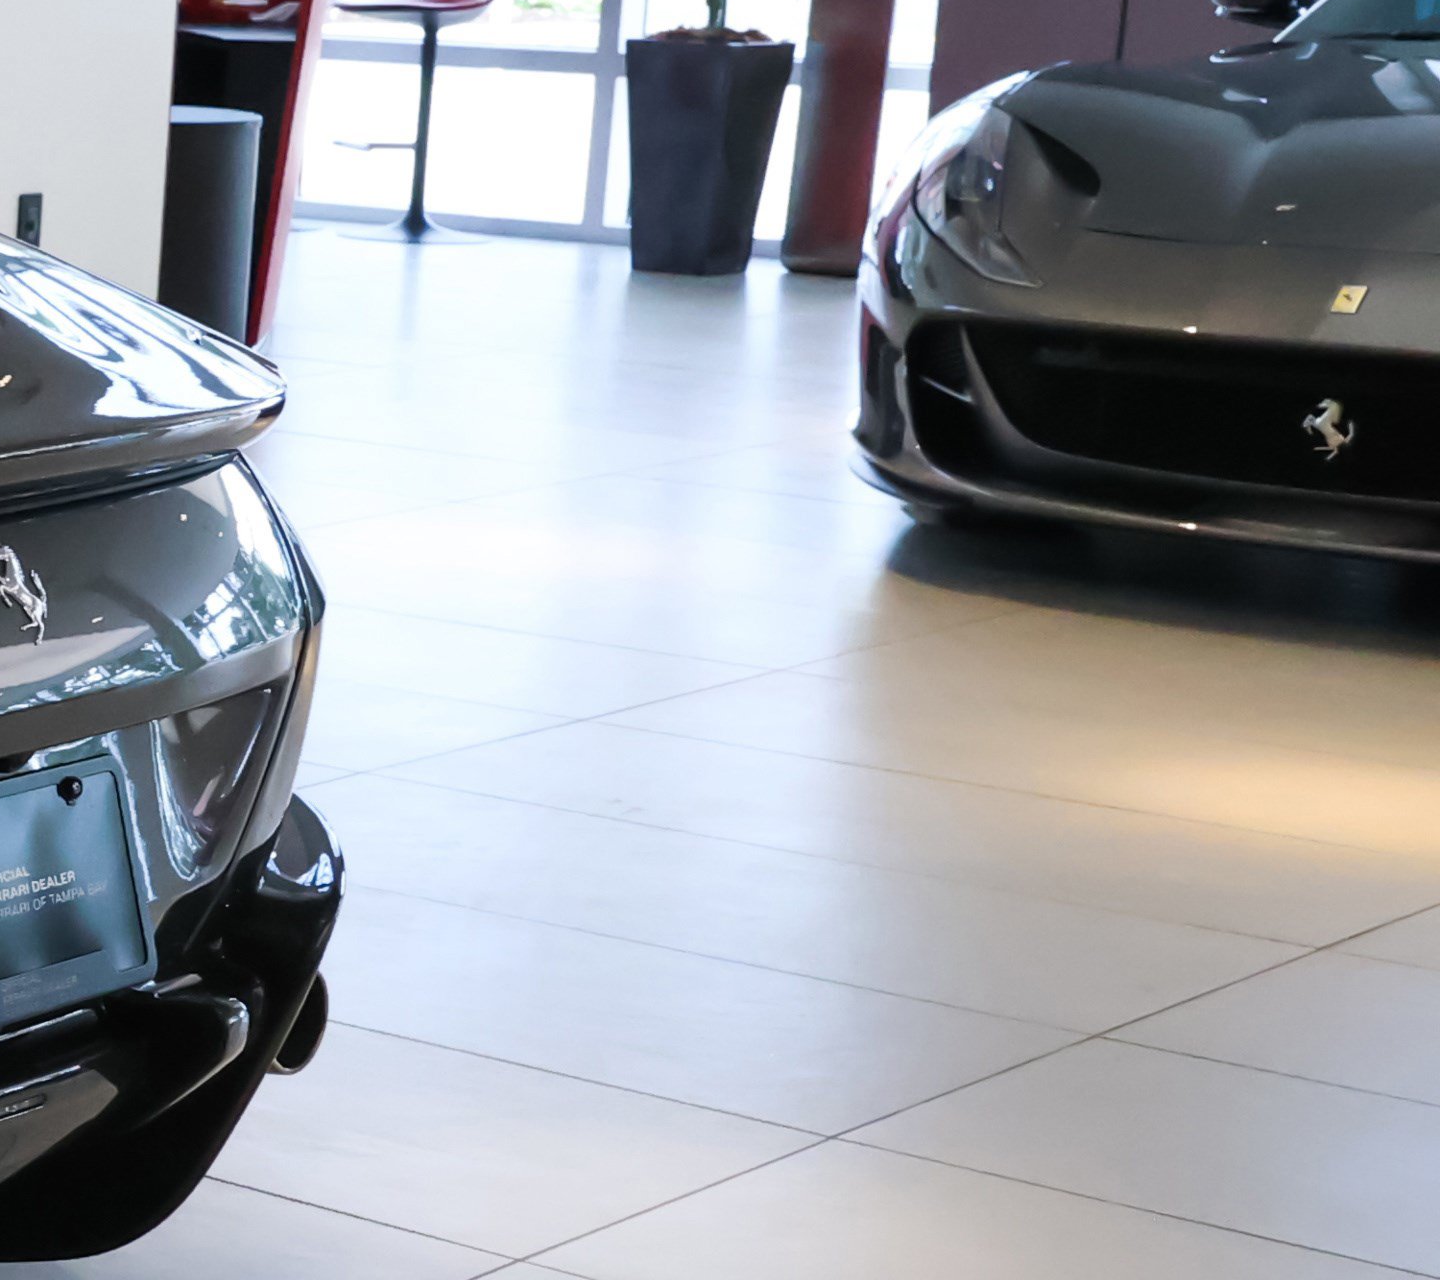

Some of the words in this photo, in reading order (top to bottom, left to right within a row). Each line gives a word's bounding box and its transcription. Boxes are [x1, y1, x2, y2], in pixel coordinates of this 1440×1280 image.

[31, 870, 76, 894] DEALER
[32, 896, 47, 911] OF
[48, 886, 85, 905] TAMPA
